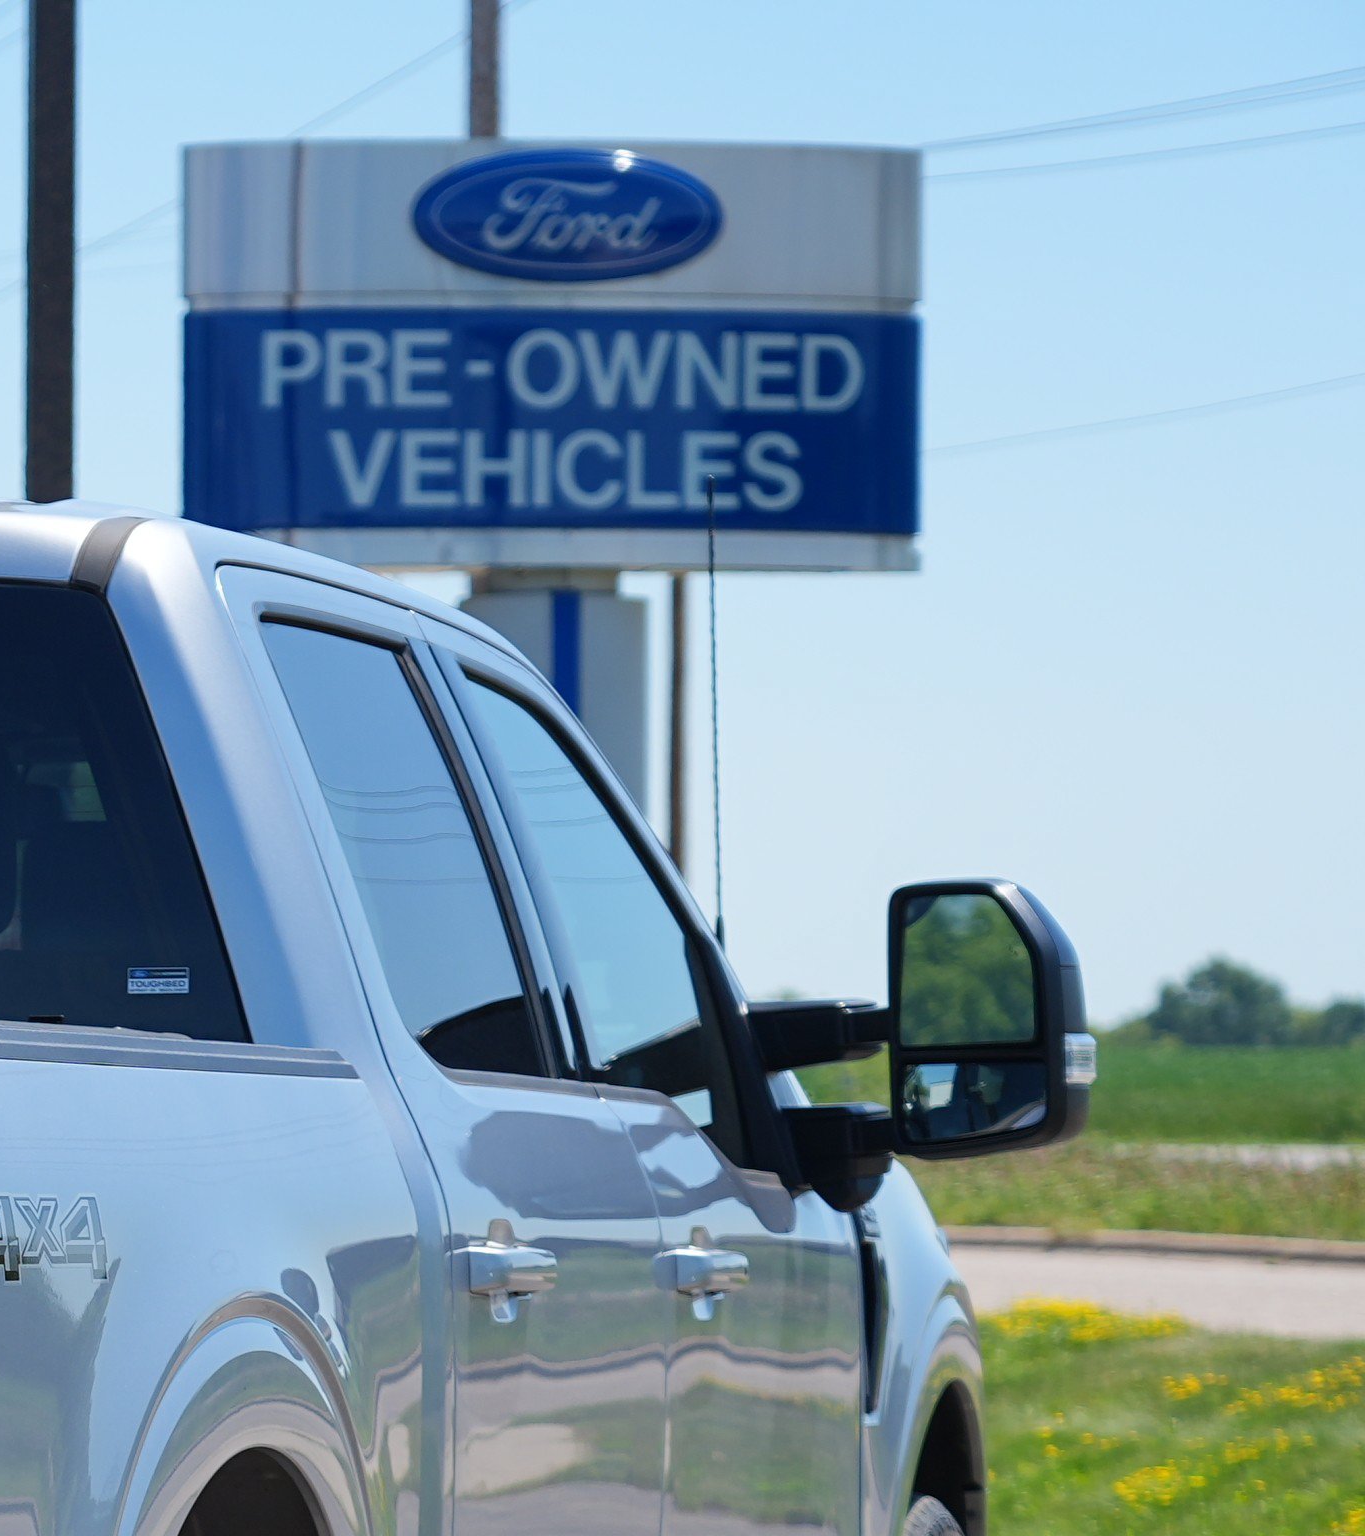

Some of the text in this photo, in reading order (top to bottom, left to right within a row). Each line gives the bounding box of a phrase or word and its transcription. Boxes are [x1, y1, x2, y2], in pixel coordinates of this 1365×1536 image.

[480, 175, 661, 251] Ford
[260, 328, 865, 415] PRE-OWNED
[329, 428, 803, 513] VEHICLES
